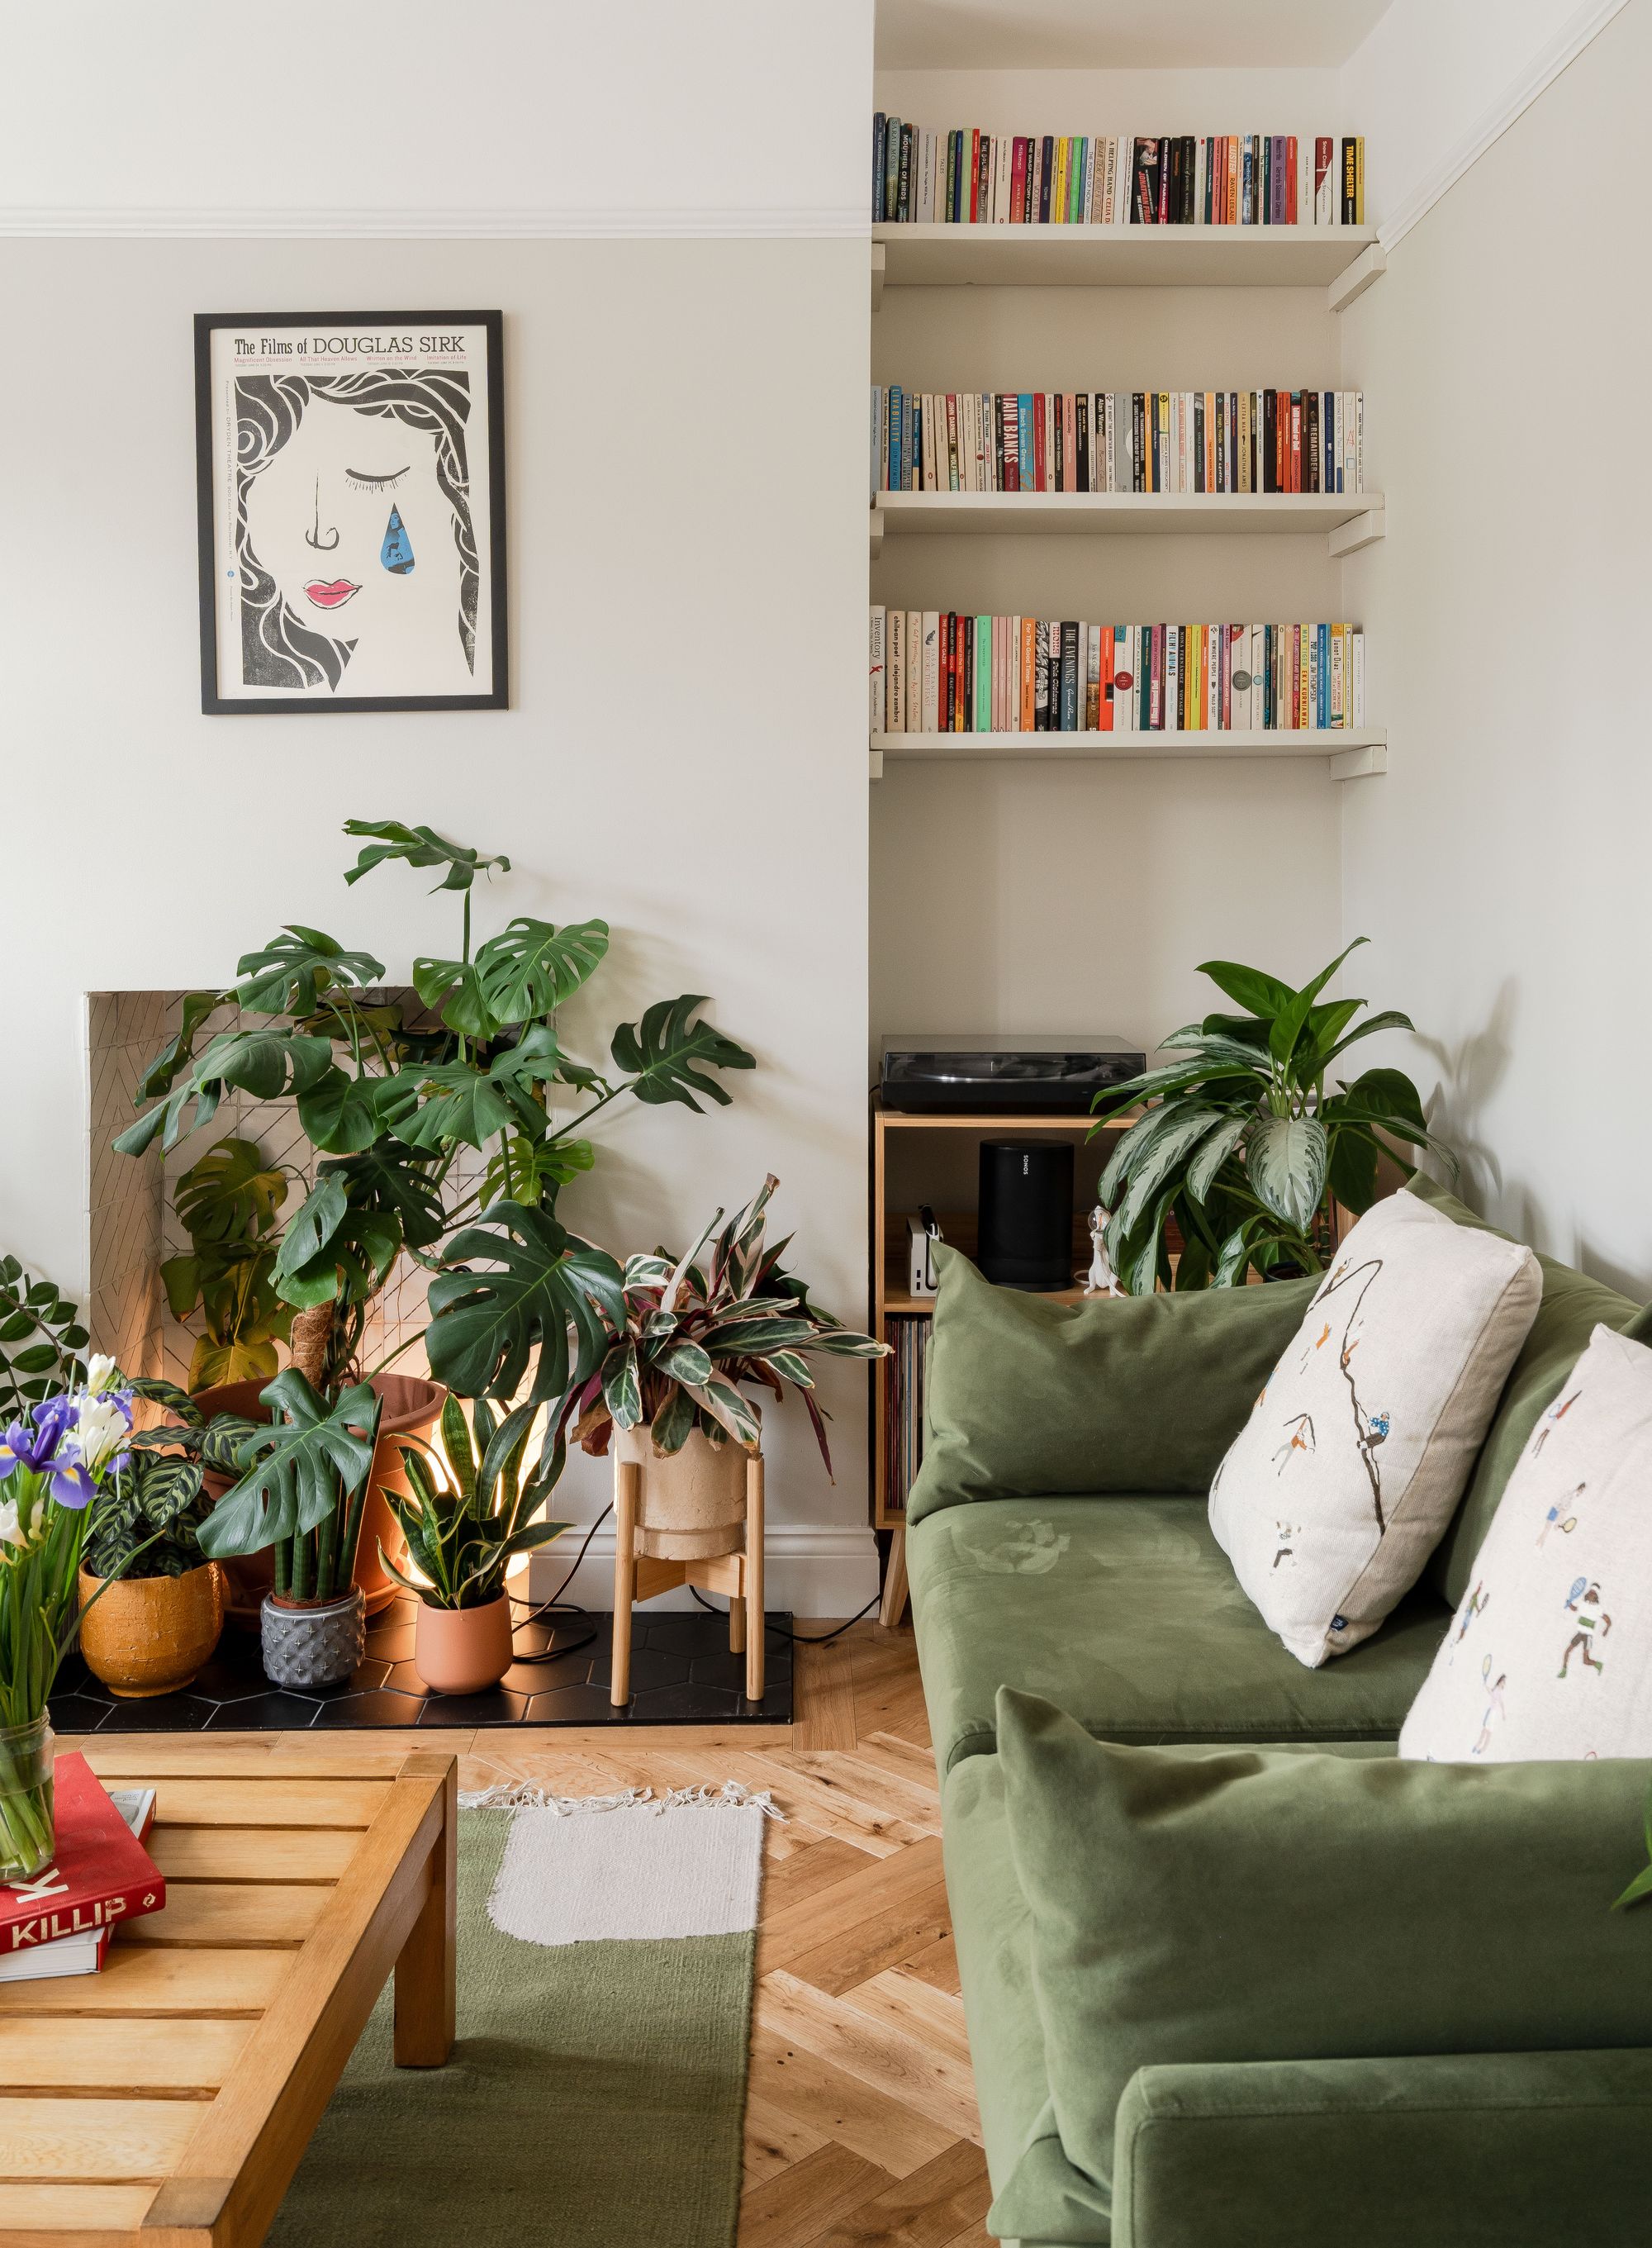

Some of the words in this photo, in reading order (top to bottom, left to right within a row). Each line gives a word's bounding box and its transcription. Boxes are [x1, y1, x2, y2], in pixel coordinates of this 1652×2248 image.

[1346, 145, 1354, 165] TIME
[901, 171, 907, 180] OF
[1138, 171, 1148, 206] JONATHAN
[1162, 173, 1168, 183] OF
[1346, 166, 1355, 198] SHELTER
[888, 173, 896, 217] Summerwater
[1093, 198, 1102, 222] TALKING
[235, 339, 255, 355] The
[260, 338, 293, 354] Films
[297, 338, 308, 354] of
[313, 337, 414, 354] DOUGLAS
[420, 336, 465, 353] SIRK
[891, 389, 900, 443] LIVABILITY
[1004, 397, 1018, 421] IAIN
[1004, 425, 1018, 463] BANKS
[873, 616, 882, 659] Inventory
[1066, 629, 1076, 643] THE
[1333, 639, 1341, 656] Junot
[892, 641, 900, 658] poet
[1066, 646, 1075, 684] EVENINGS
[1168, 651, 1176, 677] ANIMALS
[892, 664, 900, 696] alejandro
[12, 1897, 127, 1949] KILLIP
